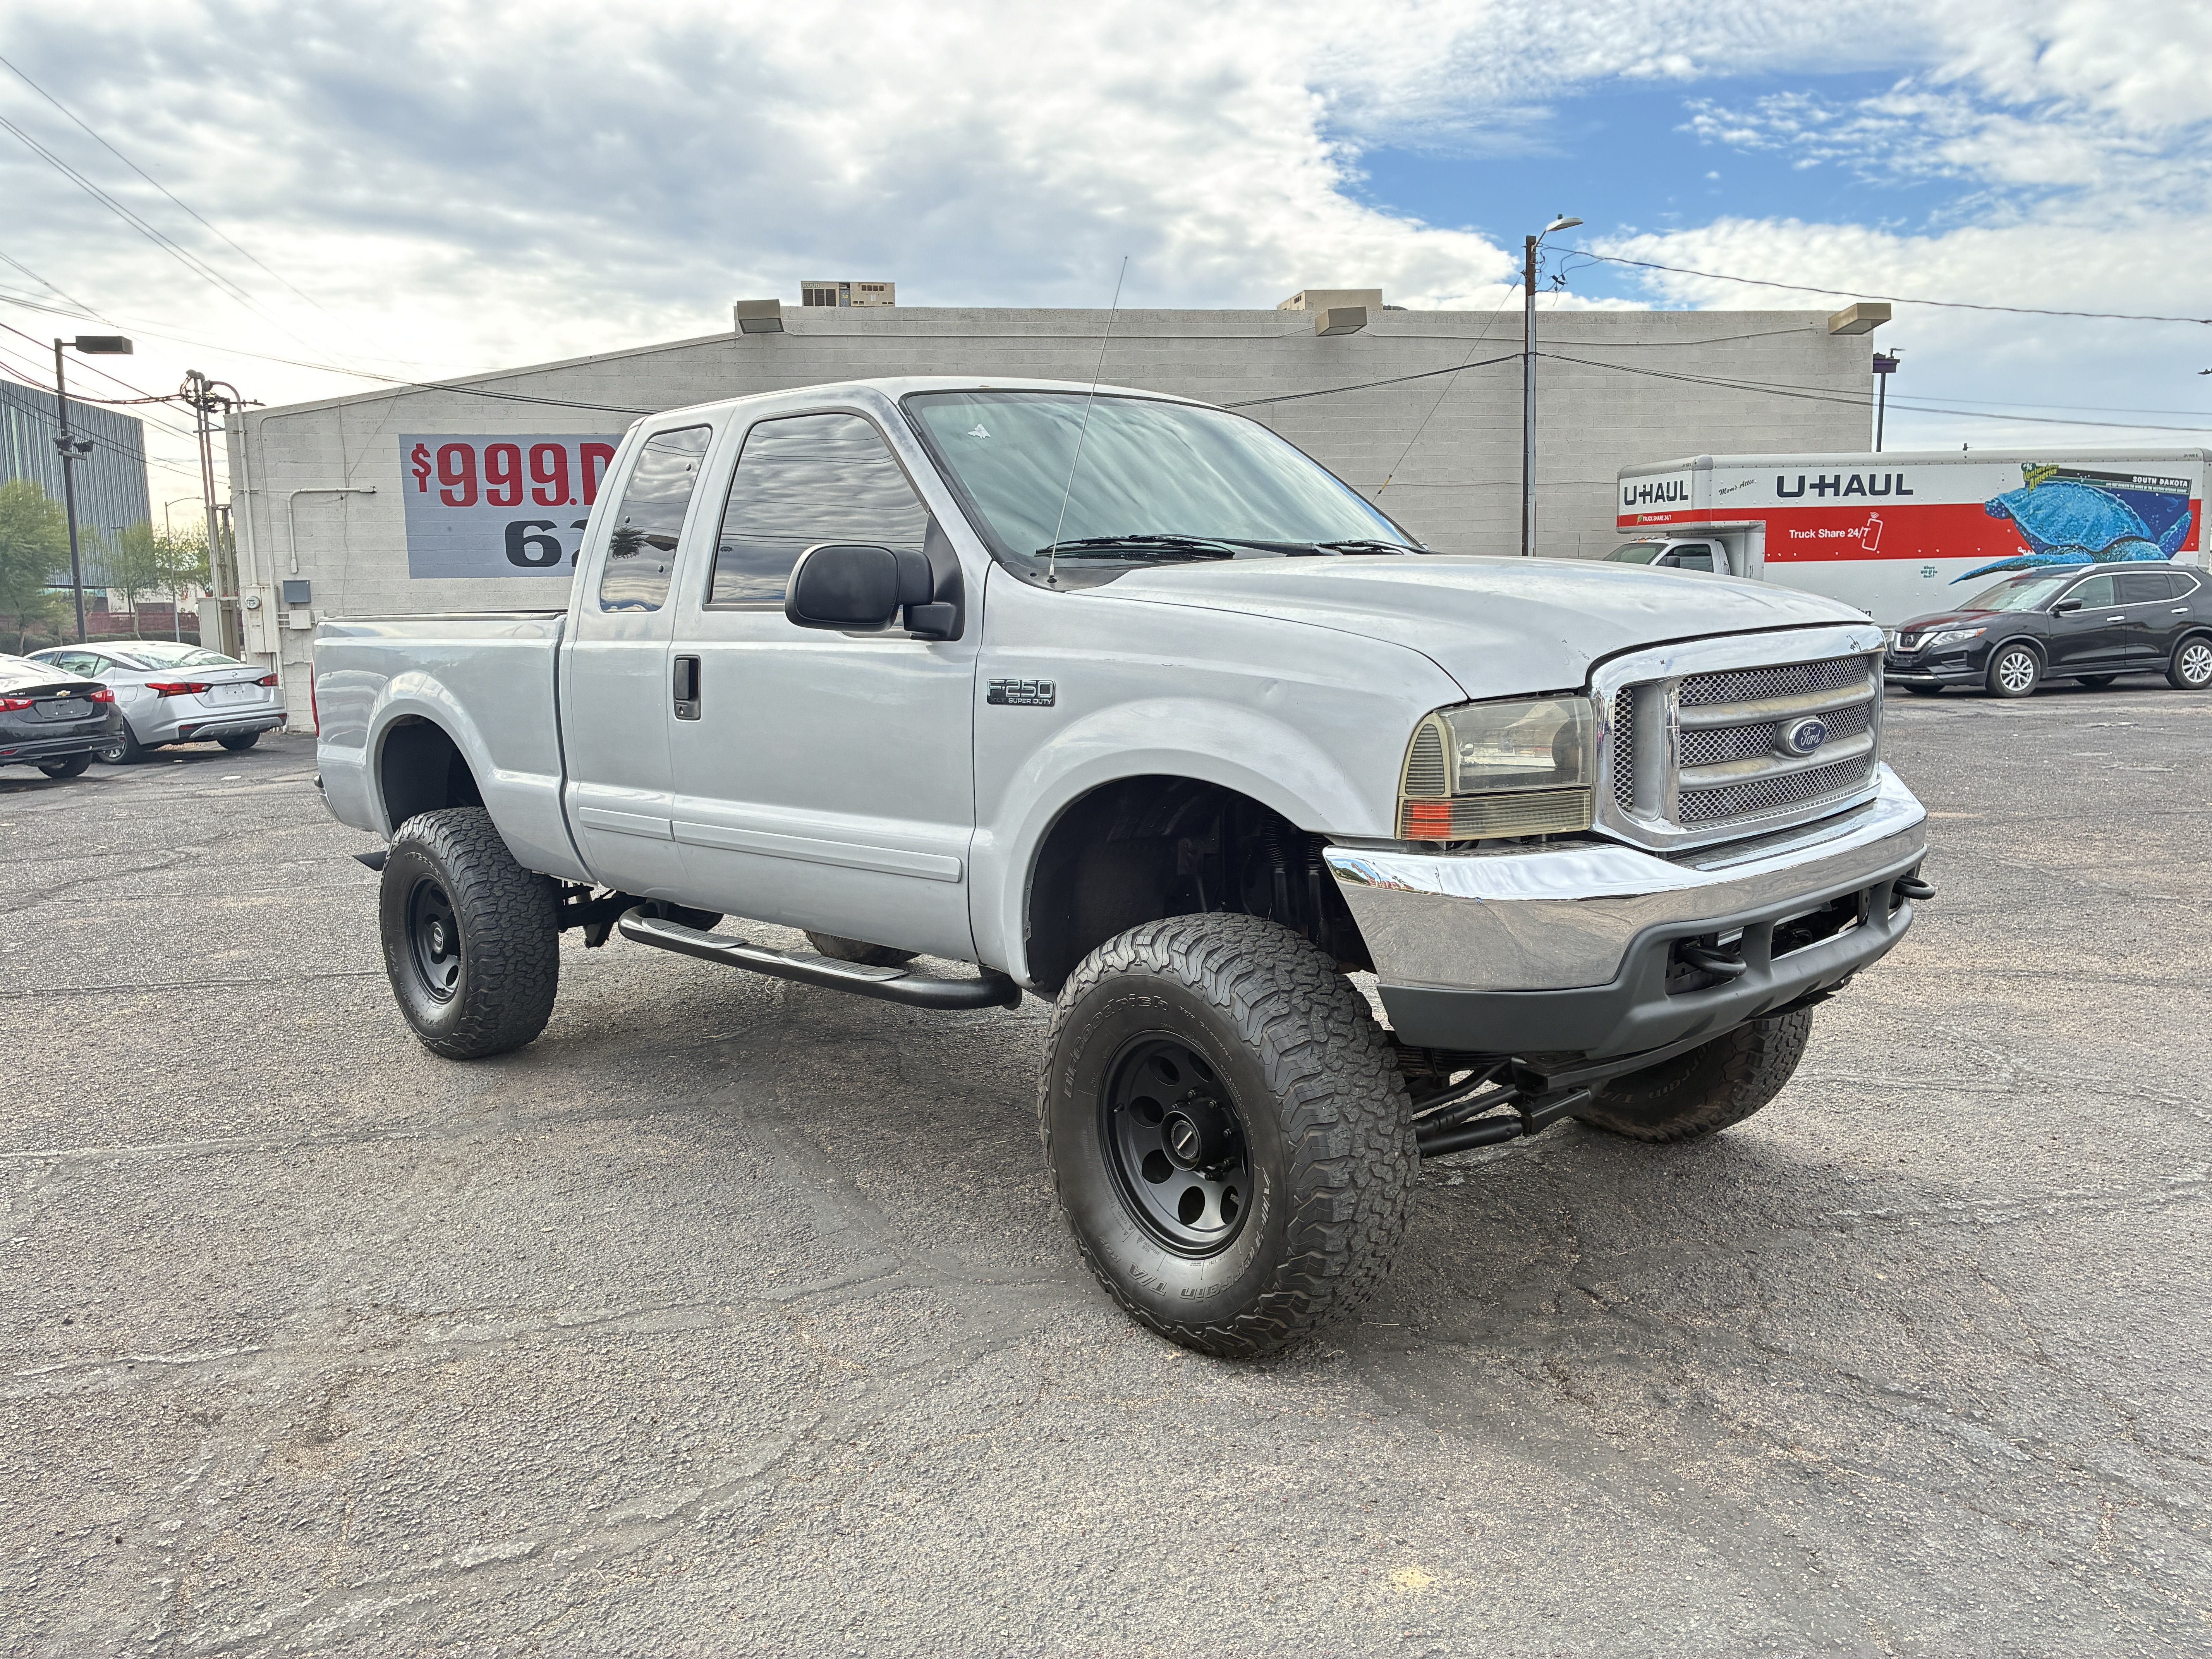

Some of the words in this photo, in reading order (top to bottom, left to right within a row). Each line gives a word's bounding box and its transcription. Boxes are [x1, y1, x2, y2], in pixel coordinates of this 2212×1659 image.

[1777, 474, 1914, 498] U-HAUL
[2028, 468, 2057, 493] America
[2132, 476, 2157, 484] SOUTH
[2159, 478, 2188, 487] DAKOTA
[1624, 480, 1689, 506] U-HAUL
[1789, 529, 1816, 539] Truck
[1818, 528, 1846, 538] Share
[1847, 526, 1869, 539] 24/7
[1801, 726, 1820, 746] Ford
[1064, 993, 1169, 1099] BFGoodrich
[1127, 1261, 1167, 1296] T/A
